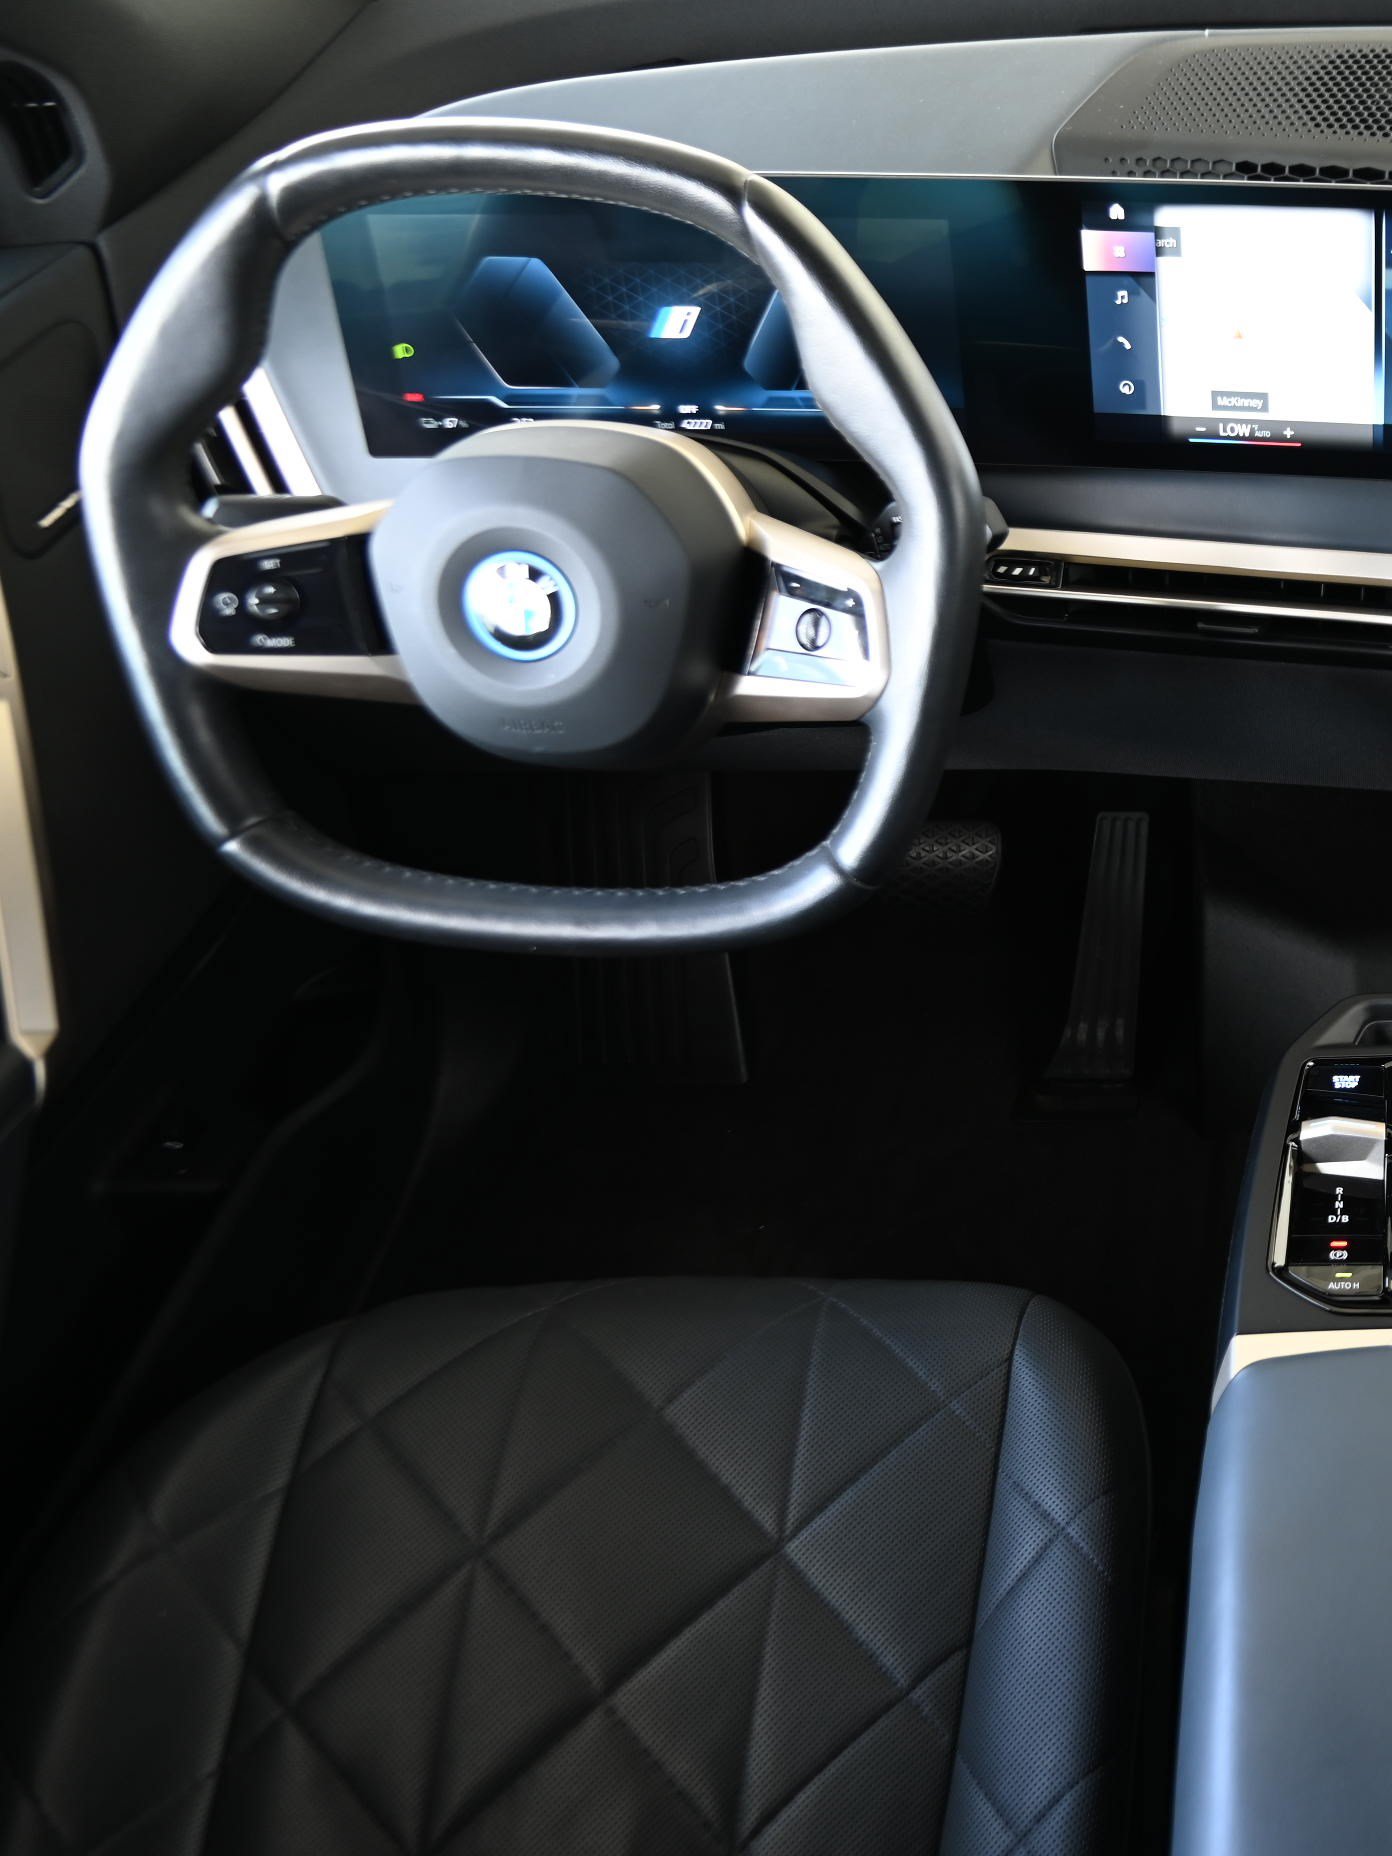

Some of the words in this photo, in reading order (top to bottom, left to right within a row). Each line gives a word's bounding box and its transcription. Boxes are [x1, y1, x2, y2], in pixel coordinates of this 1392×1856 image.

[1216, 396, 1264, 410] McKinney
[1218, 422, 1251, 437] LOW
[1254, 430, 1271, 438] AUTO
[1335, 1187, 1344, 1195] R
[1334, 1201, 1344, 1209] N
[1327, 1215, 1350, 1223] D/B
[1328, 1281, 1352, 1290] AUTO
[1353, 1282, 1360, 1290] H
